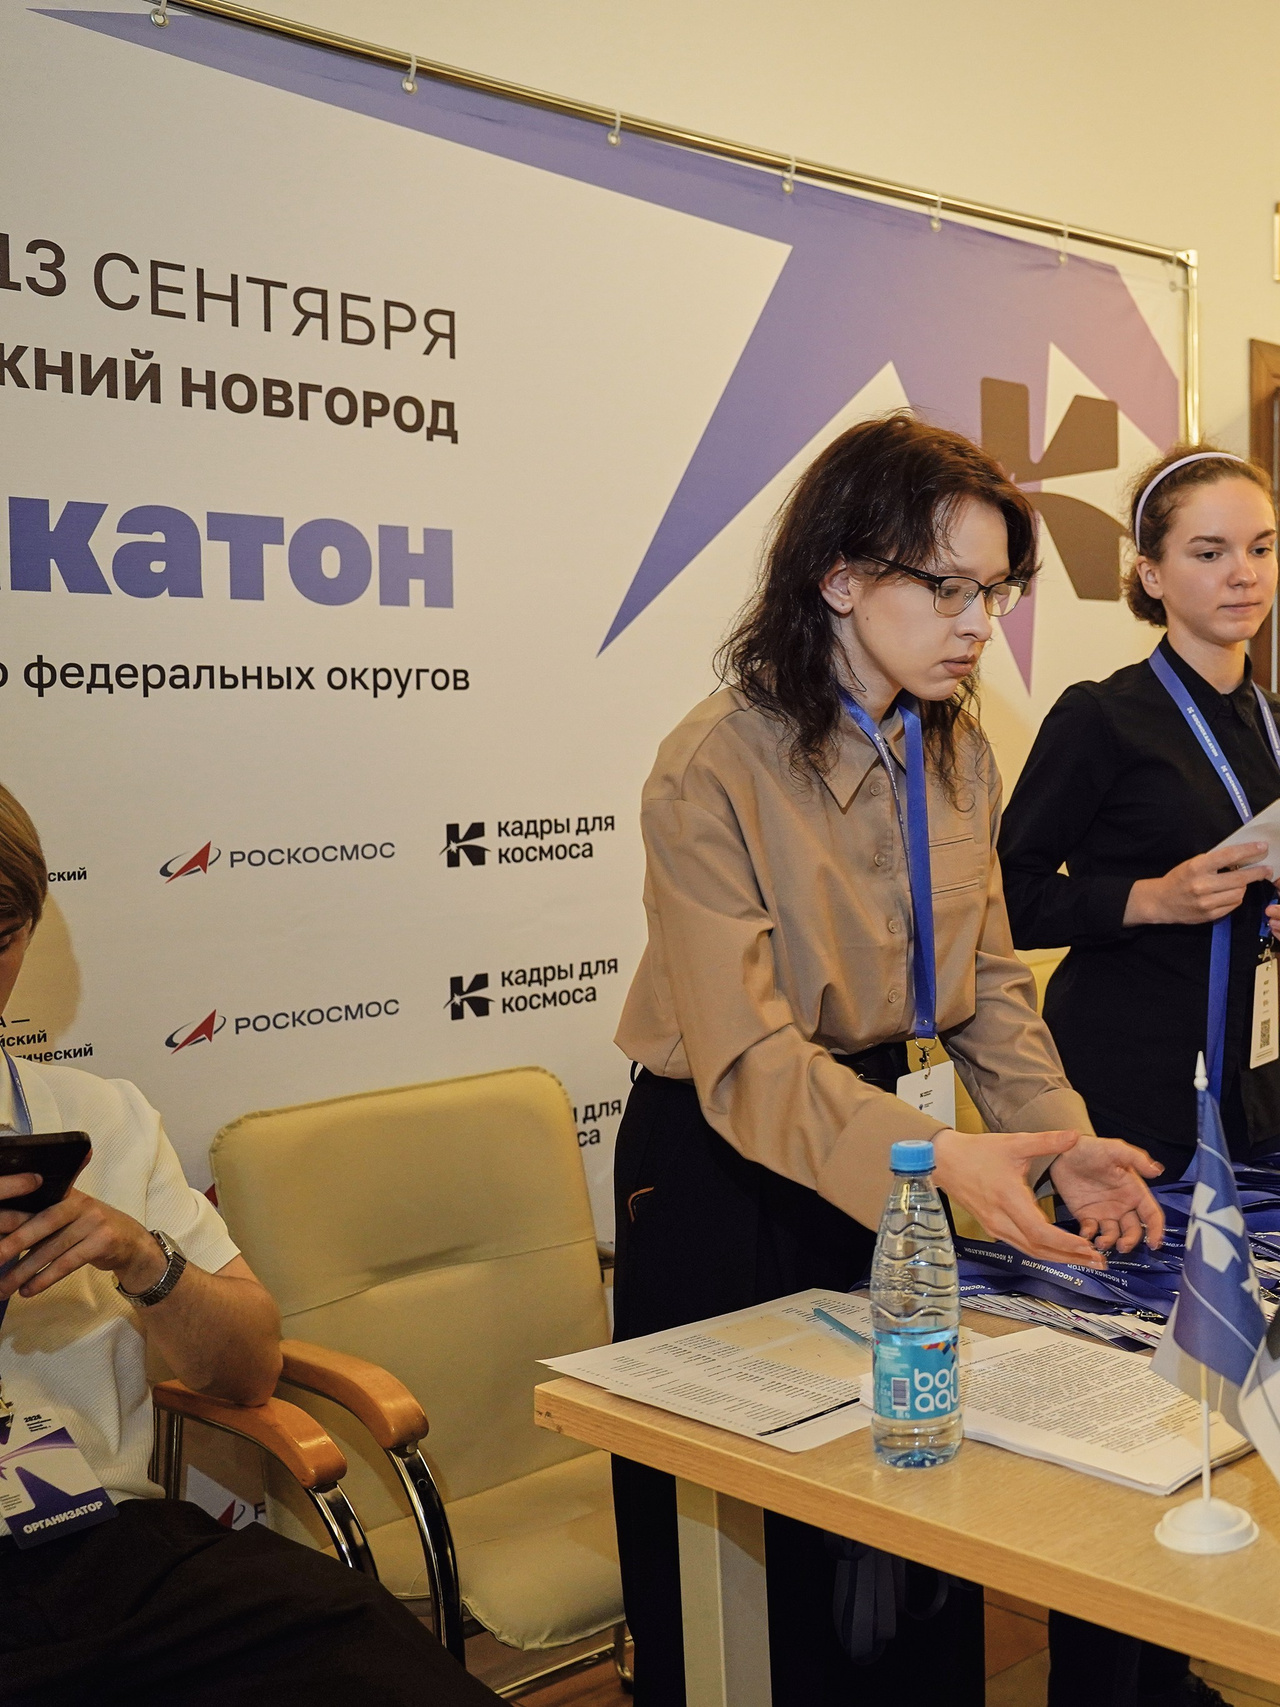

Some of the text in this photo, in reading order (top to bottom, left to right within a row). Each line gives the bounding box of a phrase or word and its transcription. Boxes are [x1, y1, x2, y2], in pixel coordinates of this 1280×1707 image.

[93, 252, 457, 360] СЕНТЯБРЯ
[181, 367, 458, 444] НОВГОРОД
[0, 496, 454, 610] катон
[23, 654, 315, 698] федеральных
[326, 666, 470, 700] округов
[497, 815, 615, 840] кадры для
[229, 842, 396, 868] РОСКОСМОС
[498, 842, 594, 864] космоса
[47, 866, 87, 883] ский
[501, 958, 618, 988] кадры для
[502, 986, 597, 1014] космоса
[235, 999, 400, 1035] РОСКОСМОС
[582, 1099, 622, 1124] для
[1021, 1259, 1074, 1281] КОСМОХАКАТОН
[914, 1386, 958, 1413] aqu
[22, 1500, 104, 1535] ОРГАНИЗАТОР
